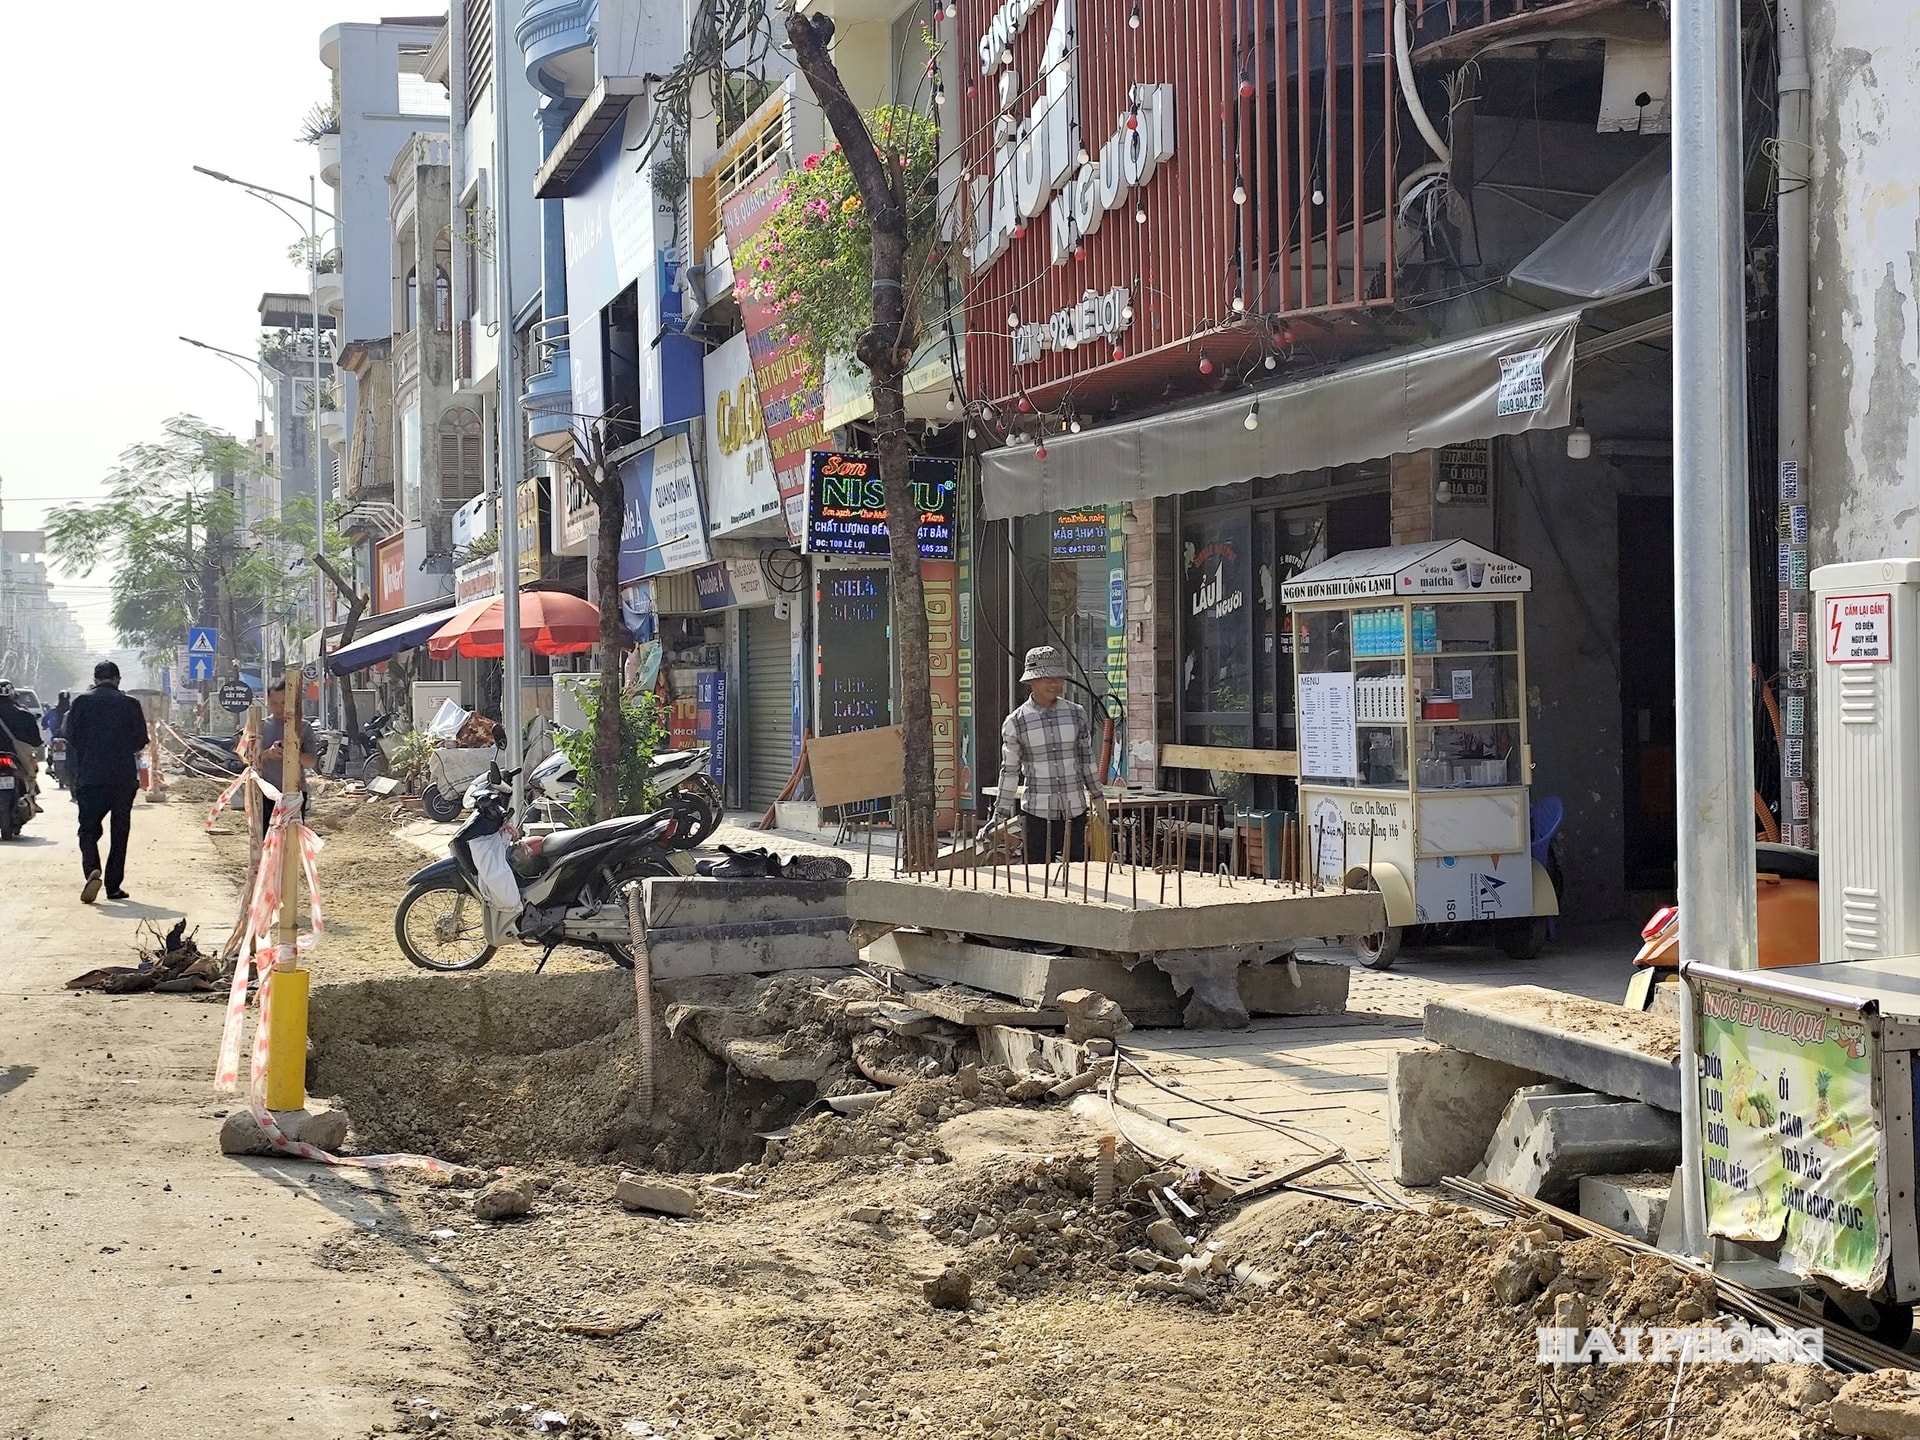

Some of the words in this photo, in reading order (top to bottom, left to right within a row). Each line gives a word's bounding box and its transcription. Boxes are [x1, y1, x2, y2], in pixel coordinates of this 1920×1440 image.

[822, 477, 947, 514] NISU
[814, 519, 838, 533] CHẤT
[840, 523, 869, 536] LƯỢNG
[930, 525, 949, 538] BẢN
[1193, 574, 1216, 615] LẨU
[1214, 561, 1223, 603] 1
[1283, 586, 1306, 599] NGON
[1307, 583, 1325, 597] HƠN
[1326, 583, 1342, 596] KHI
[1343, 576, 1366, 594] UỐNG
[1368, 578, 1392, 596] LẠNH
[1420, 575, 1454, 587] matcha
[1490, 573, 1518, 584] coffee
[1216, 590, 1242, 619] NGƯỜI
[1851, 635, 1864, 643] NGUY
[1301, 677, 1320, 685] MENU
[1375, 801, 1389, 817] Bạn
[1446, 899, 1456, 921] ISO
[1703, 990, 1739, 1023] NƯỚC
[1739, 997, 1759, 1027] ÉP
[1759, 1003, 1790, 1036] HOA
[1789, 1010, 1828, 1047] QUẢ
[1777, 1066, 1790, 1101] ỔI
[1706, 1087, 1723, 1120] LỰU
[1707, 1120, 1730, 1150] BƯỞI
[1778, 1111, 1803, 1140] CAM
[1729, 1159, 1749, 1192] HẤU
[1780, 1144, 1801, 1173] TRÀ
[1802, 1146, 1822, 1181] TẮC
[1806, 1188, 1835, 1221] BÔNG
[1837, 1200, 1864, 1232] CÚC
